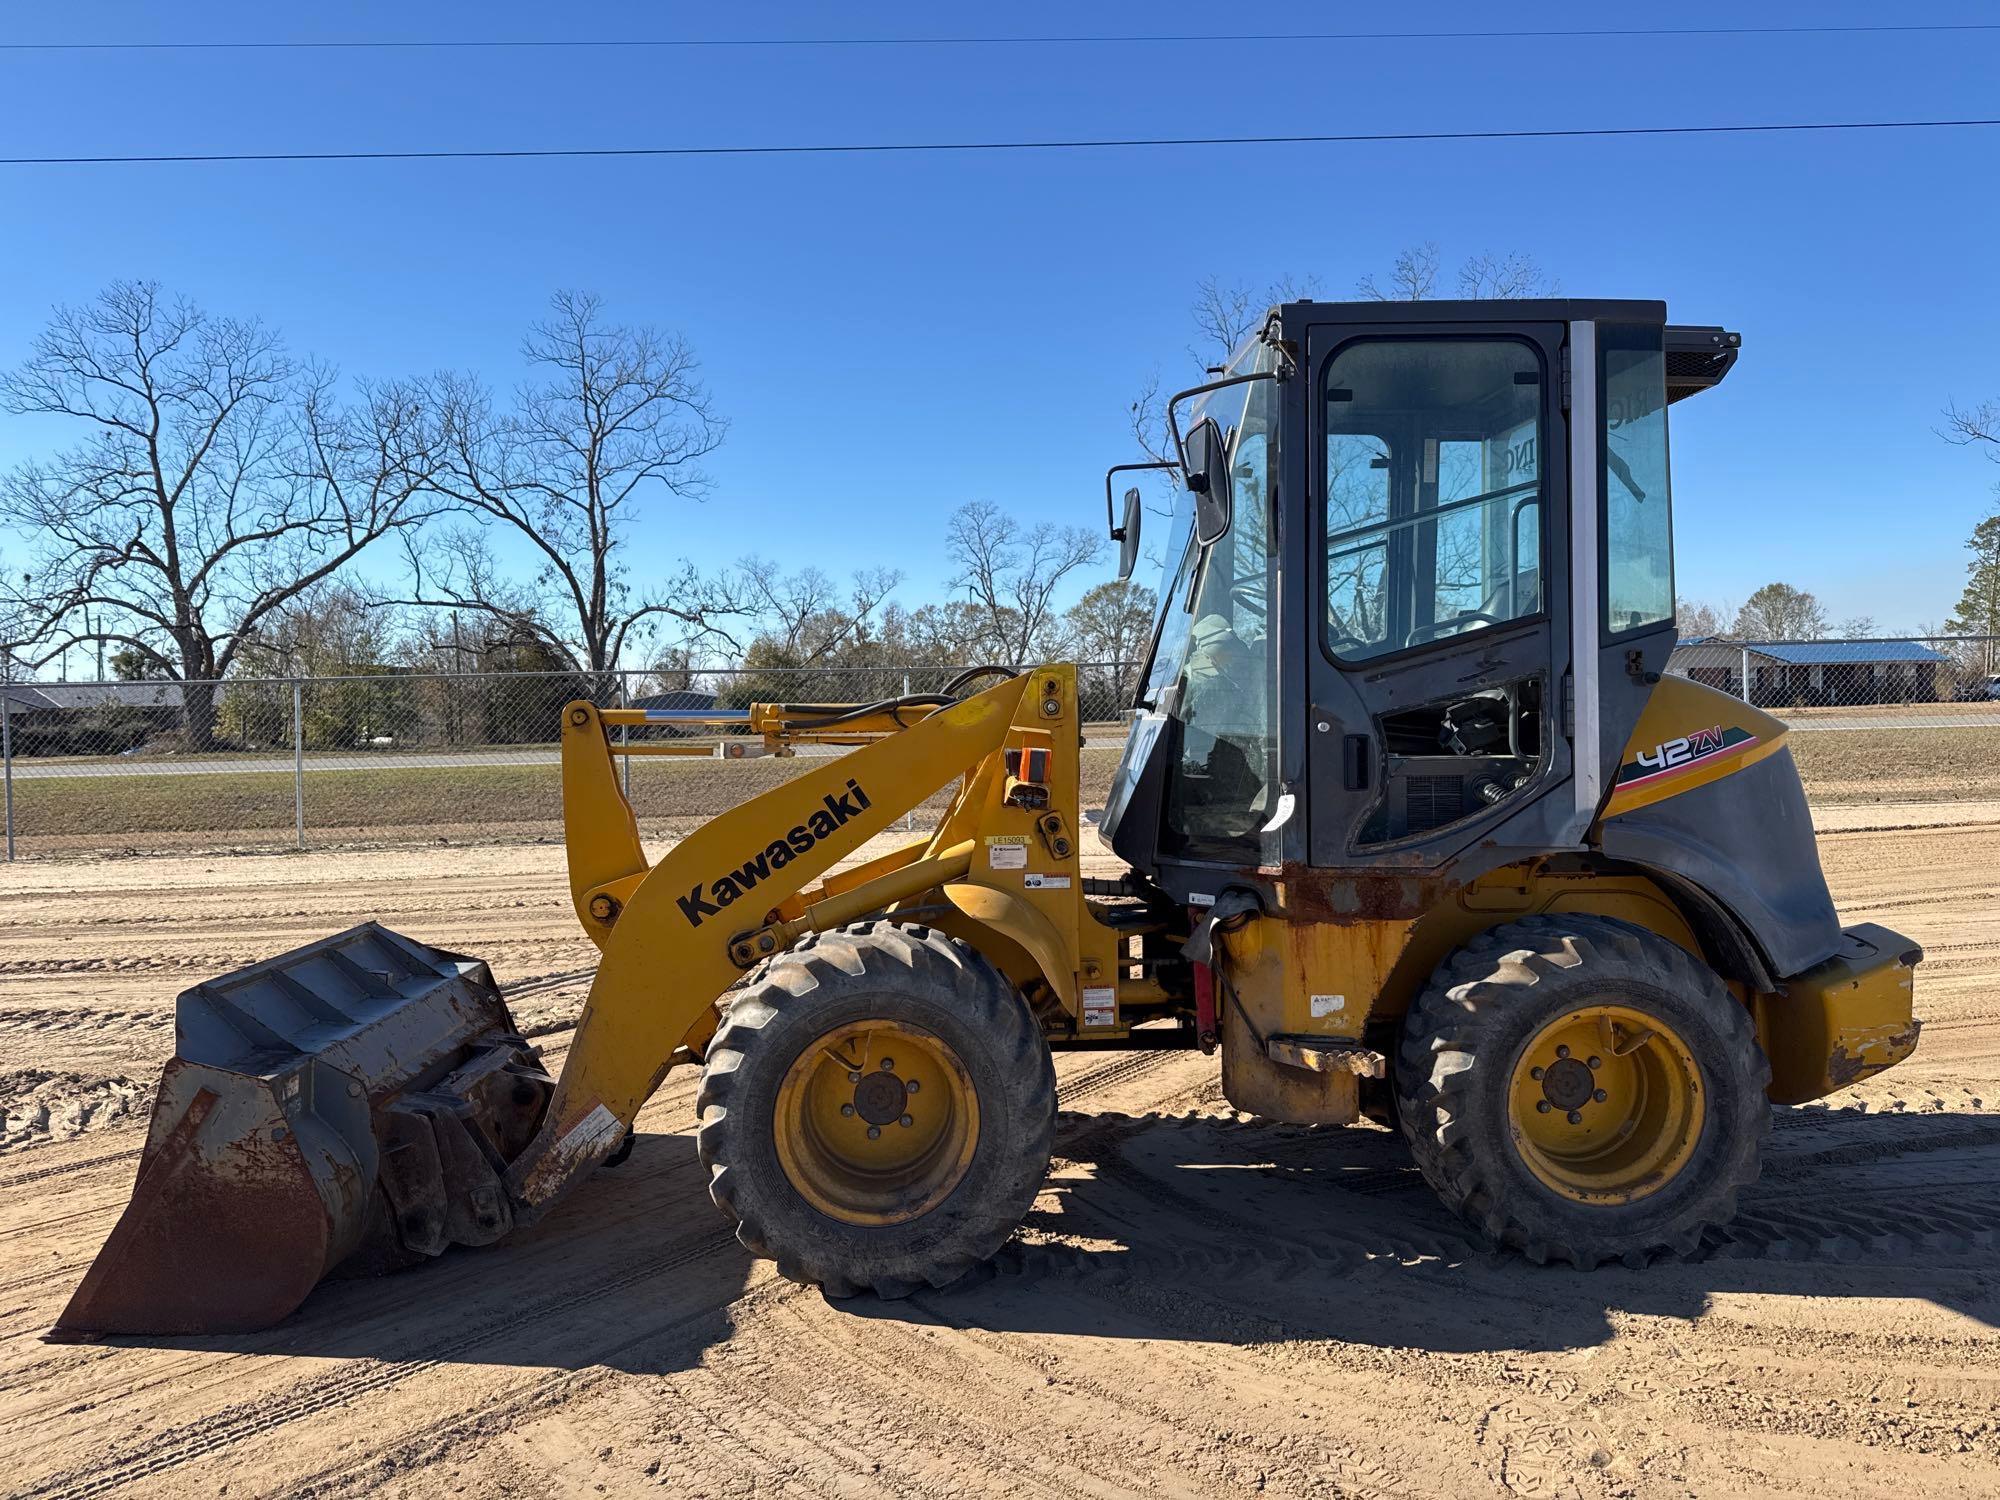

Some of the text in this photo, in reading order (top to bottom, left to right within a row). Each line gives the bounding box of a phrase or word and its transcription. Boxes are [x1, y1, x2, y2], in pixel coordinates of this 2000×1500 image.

[1636, 725, 1725, 768] 42ZV
[676, 778, 872, 928] Kawasaki
[993, 836, 1025, 844] LE15093
